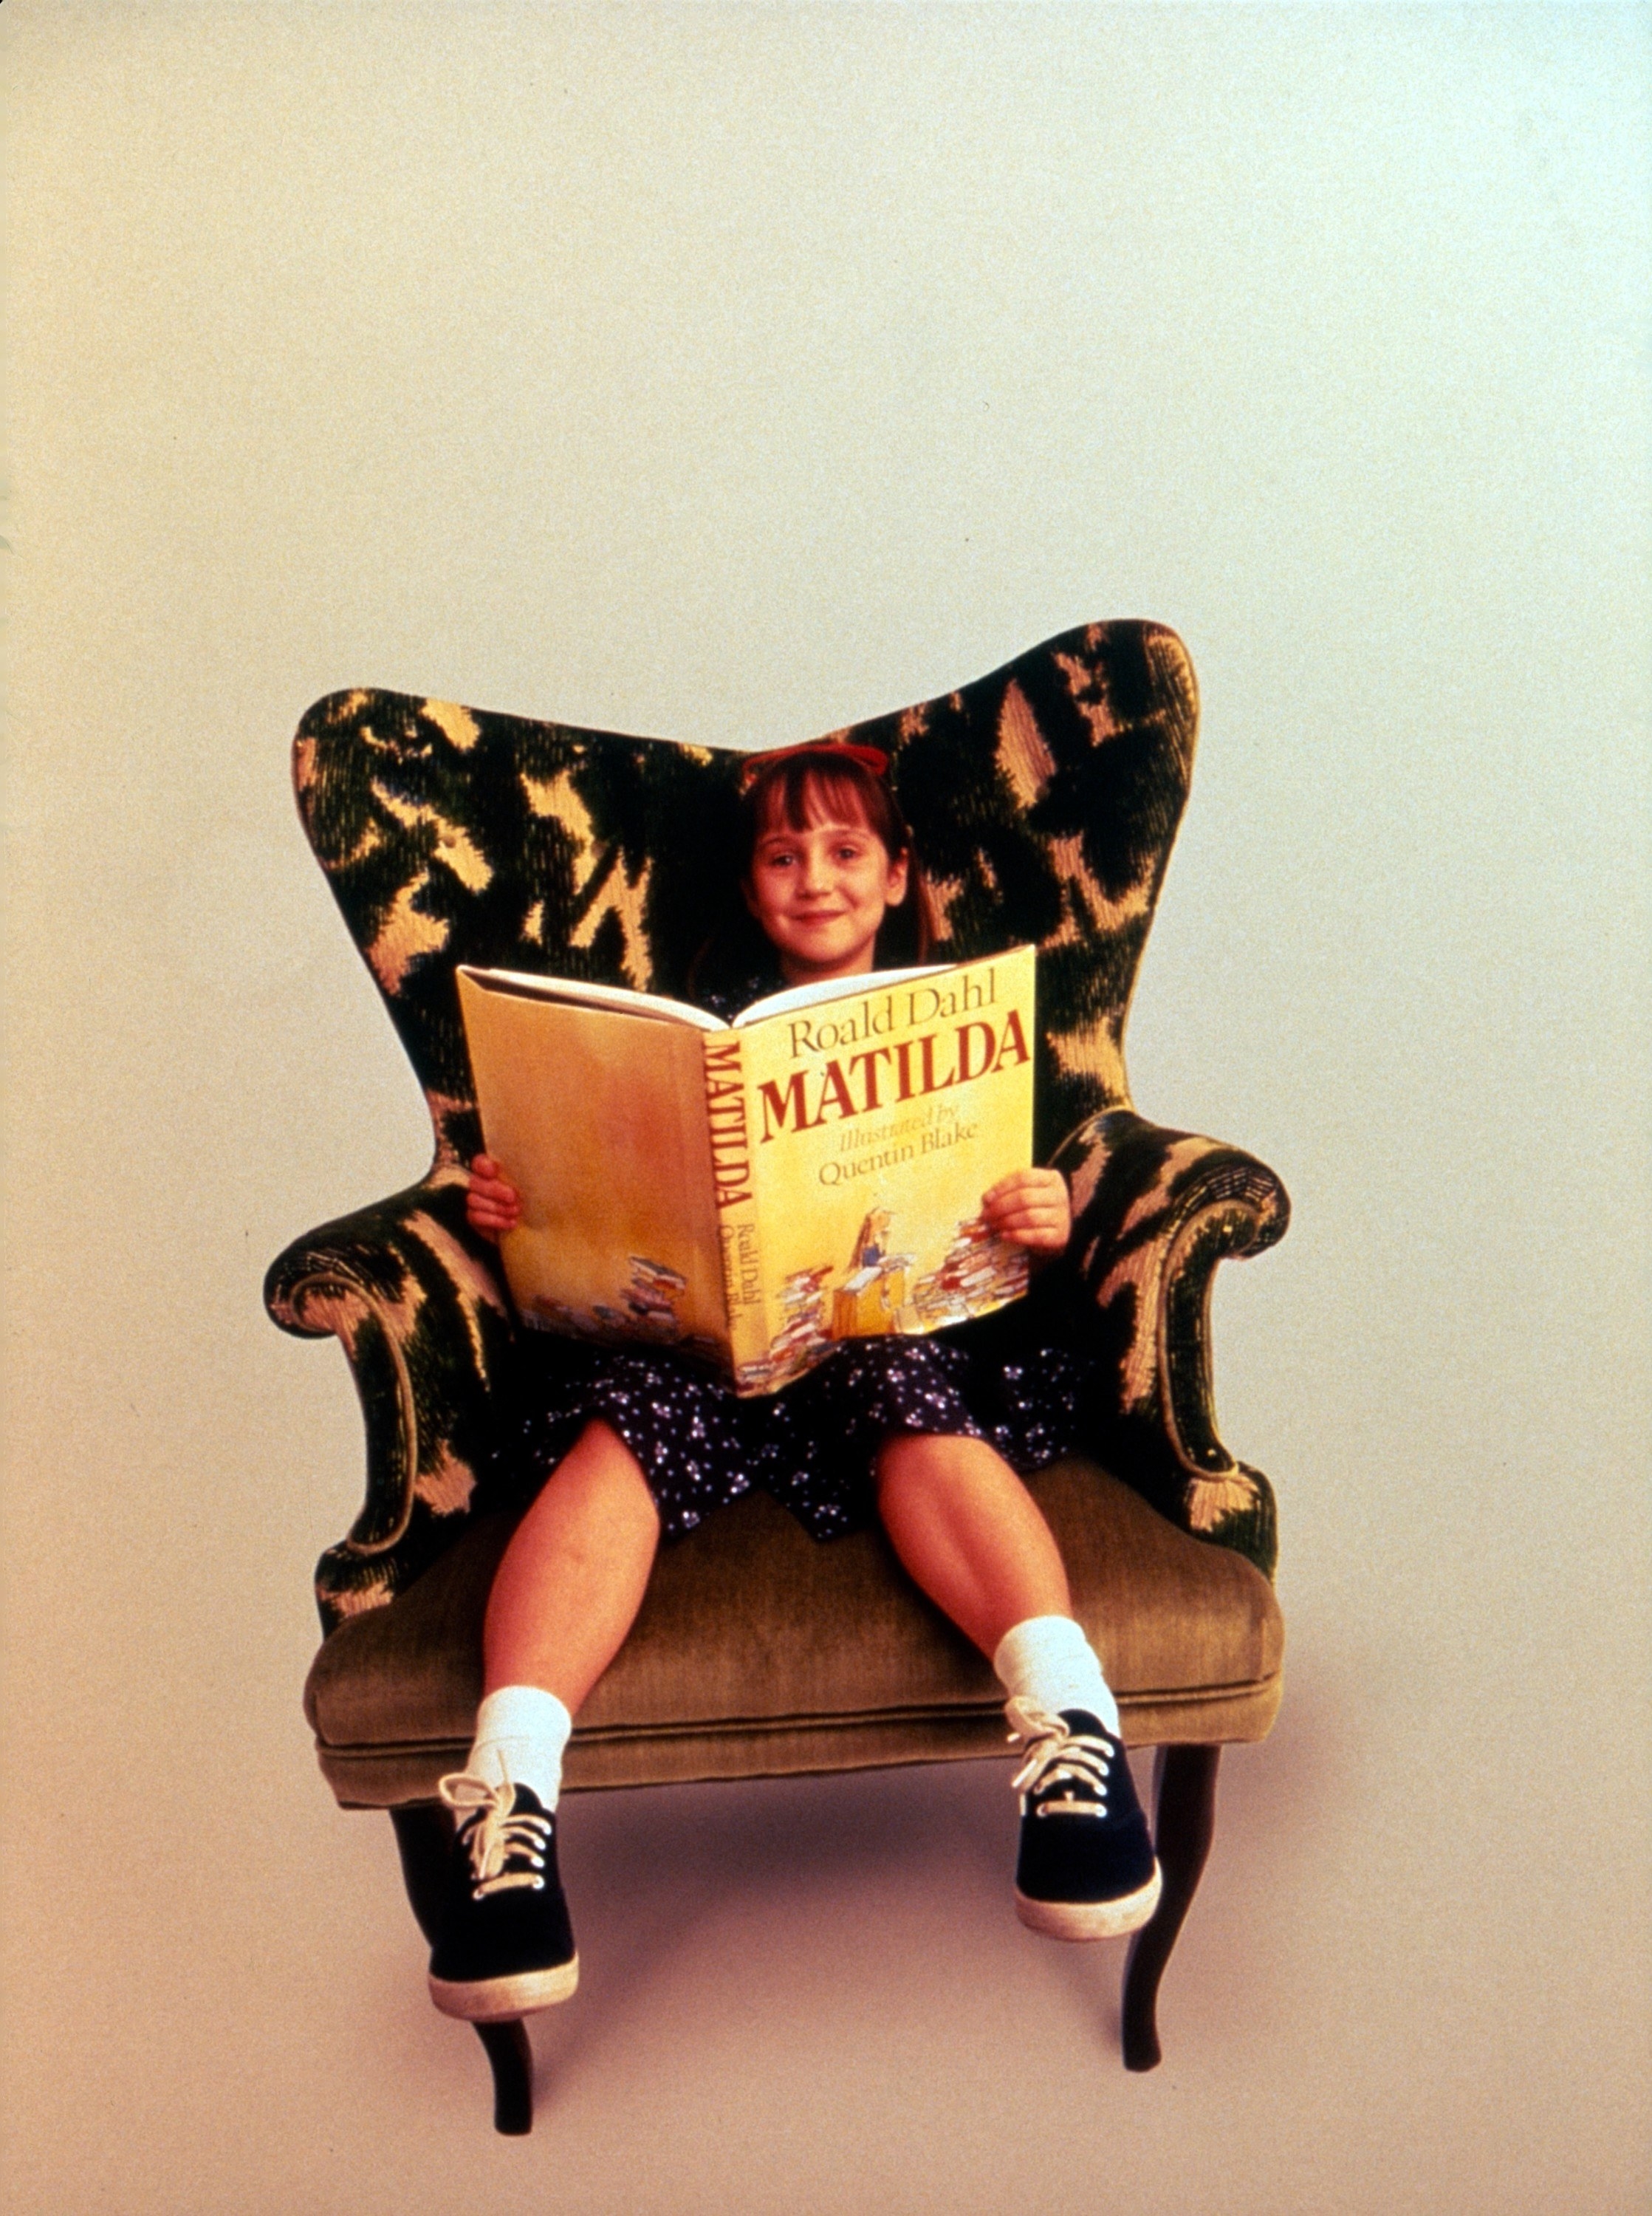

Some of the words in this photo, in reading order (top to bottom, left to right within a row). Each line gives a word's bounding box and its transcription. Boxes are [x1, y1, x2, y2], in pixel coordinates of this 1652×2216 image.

[788, 995, 893, 1058] Roald
[909, 968, 996, 1025] Dahl
[757, 1009, 1030, 1143] MATILDA
[704, 1040, 753, 1209] MATILDA
[818, 1144, 914, 1186] Quentin
[921, 1122, 978, 1155] Blake
[840, 1107, 933, 1152] Illustrated
[938, 1103, 959, 1126] by
[737, 1224, 758, 1265] Roald
[740, 1268, 761, 1305] Dahl
